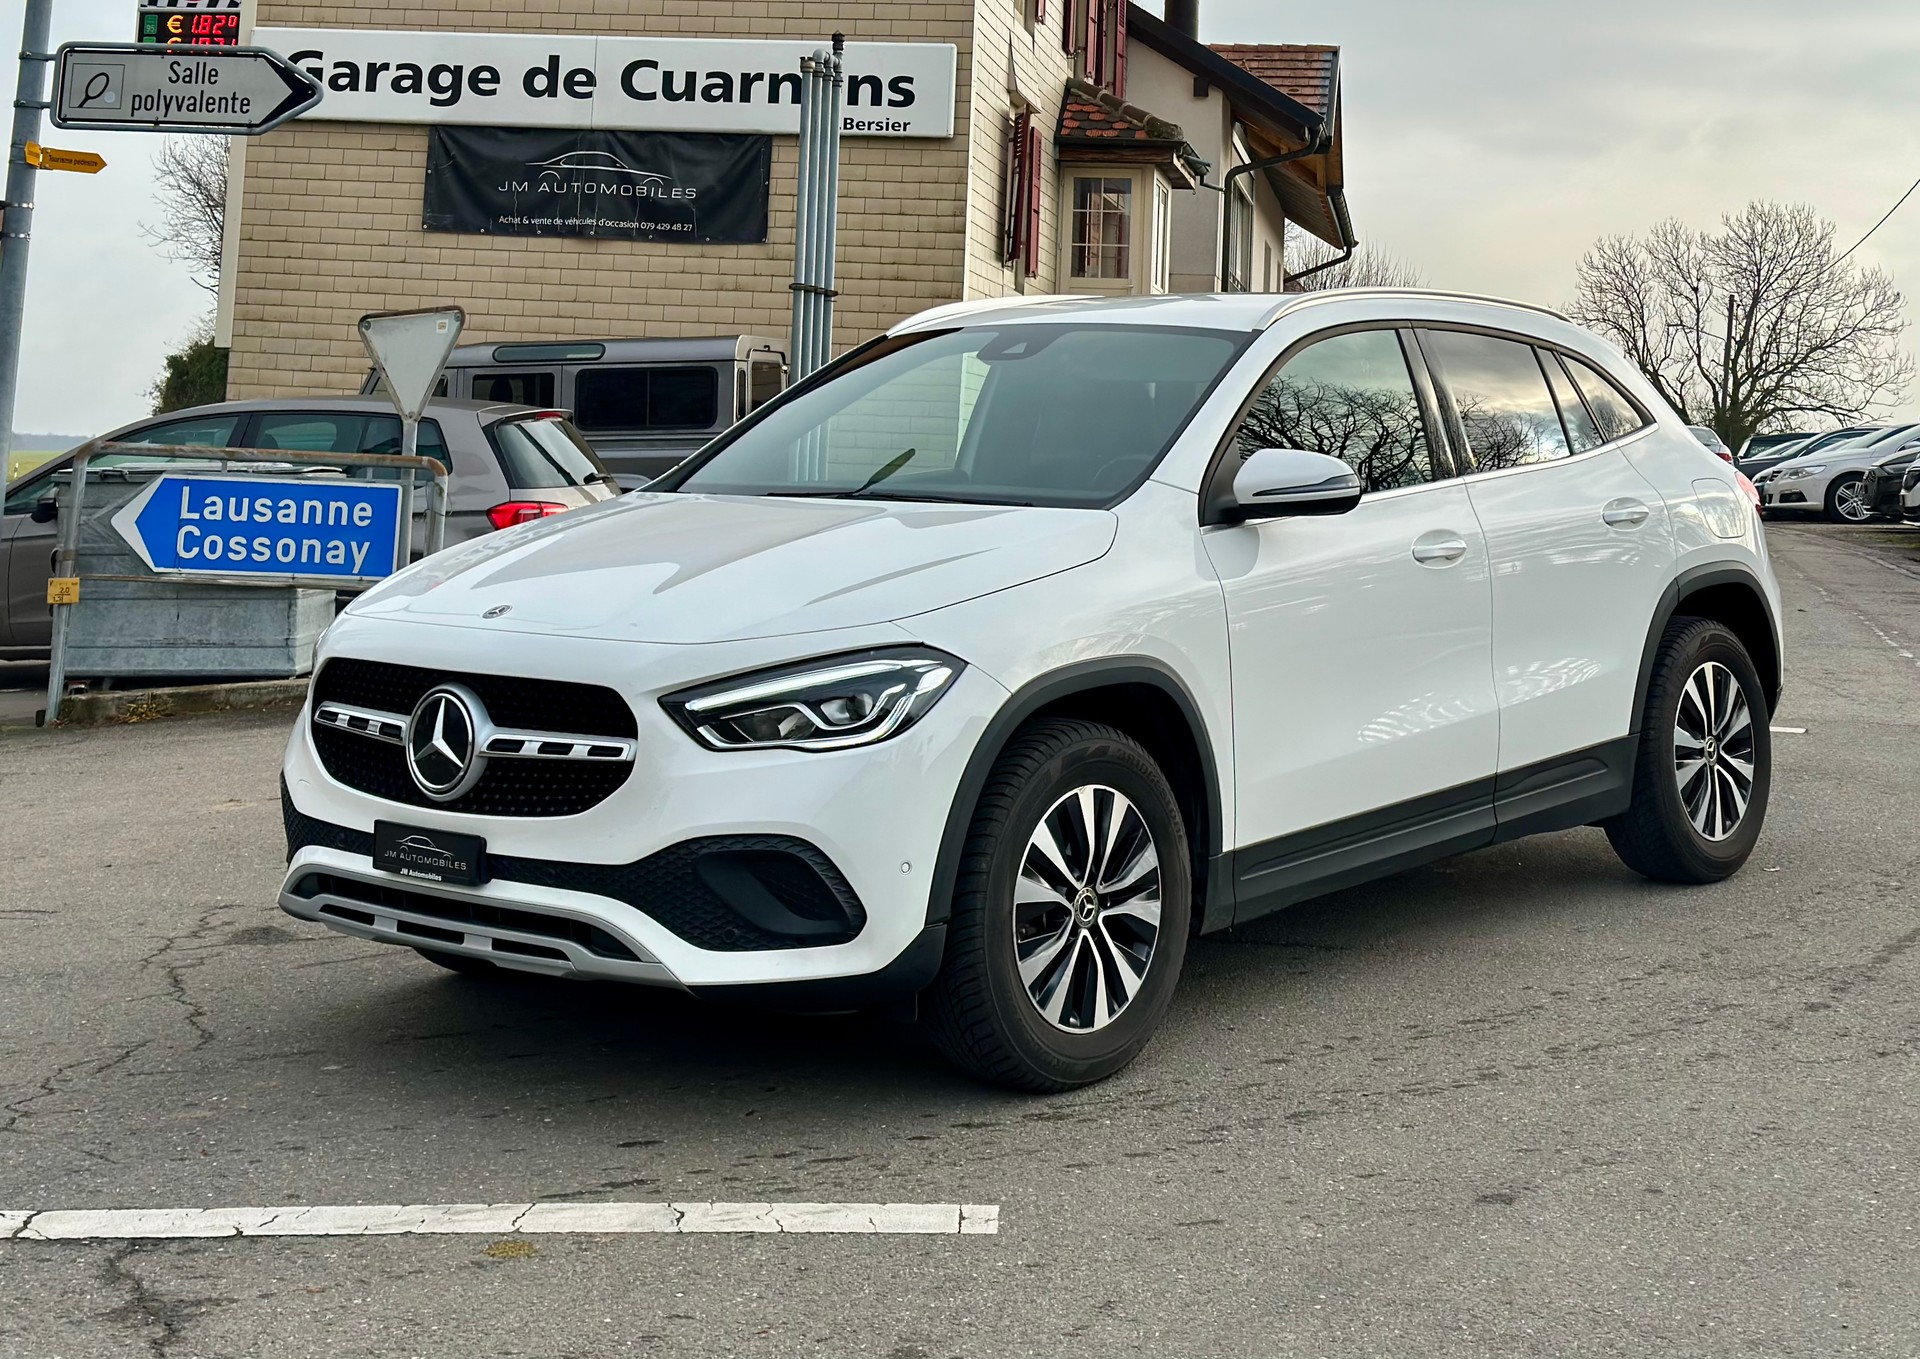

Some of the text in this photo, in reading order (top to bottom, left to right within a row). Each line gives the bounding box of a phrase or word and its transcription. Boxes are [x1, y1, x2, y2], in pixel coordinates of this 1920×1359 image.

[167, 15, 184, 34] €
[168, 60, 219, 85] Salle
[522, 54, 597, 99] de
[620, 58, 916, 108] Cuarnns
[130, 88, 251, 118] polyvalente
[498, 180, 697, 199] JM AUTOMOBILES
[499, 215, 693, 232] Achat & vente de véhicules d'occasion 079 429 48 27
[179, 485, 374, 527] Lausanne
[176, 524, 371, 574] Cossonay
[384, 850, 467, 871] JM AUTOMOBILES
[400, 868, 442, 881] JM Automobiles
